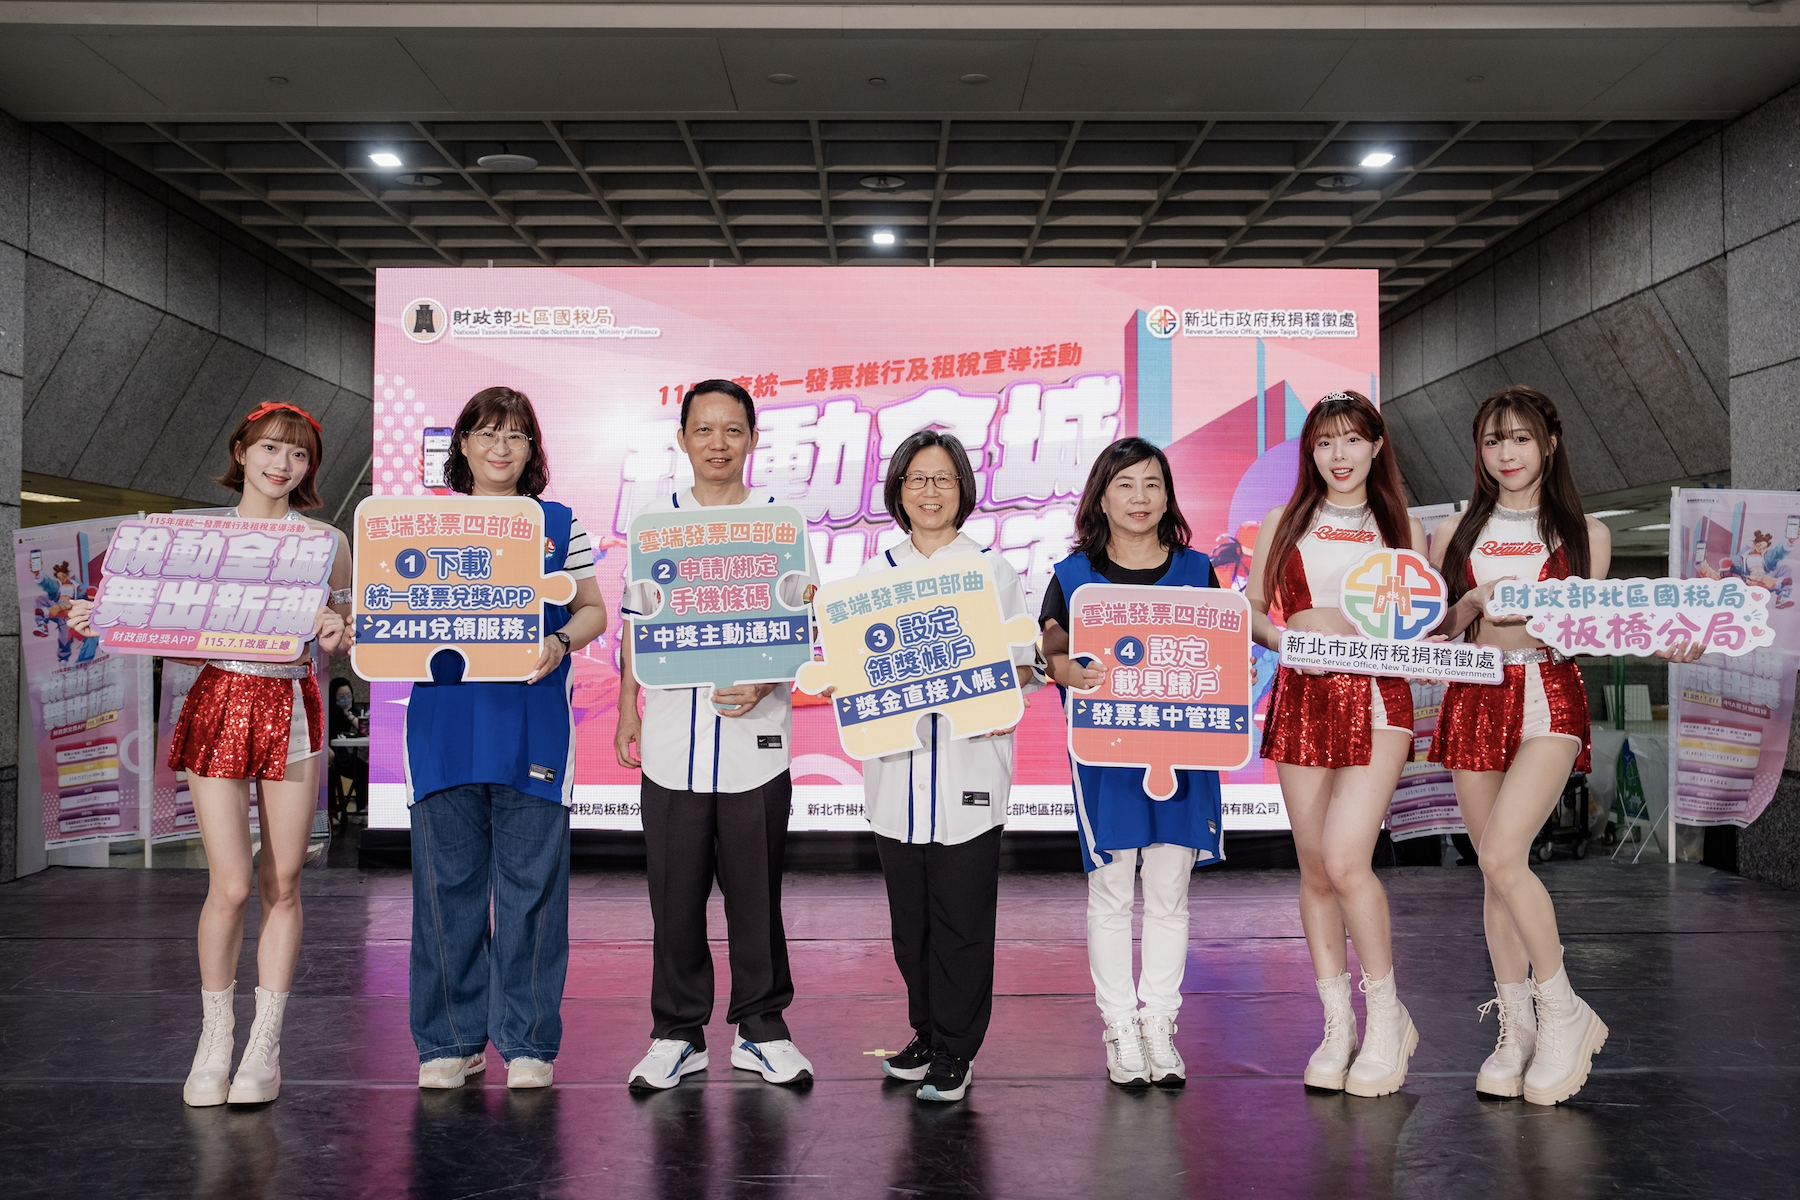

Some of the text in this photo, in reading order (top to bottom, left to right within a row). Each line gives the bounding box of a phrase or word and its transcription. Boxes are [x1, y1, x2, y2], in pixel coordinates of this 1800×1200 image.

[453, 309, 612, 326] 財政部北區國稅局
[1184, 311, 1355, 328] 新北市政府稅捐稽徵處
[599, 328, 625, 338] Ministry
[1280, 329, 1299, 337] Taipei
[1300, 329, 1313, 337] City
[149, 516, 306, 533] 115年度統一發票推行及租稅宣導活動
[366, 512, 533, 541] 雲端發票四部曲
[638, 521, 797, 554] 雲端發票四部曲
[428, 547, 491, 580] 下載
[678, 553, 779, 583] 申請/綁定
[92, 575, 325, 637] 舞出新潮
[365, 584, 535, 610] 統一發票兌獎APP
[669, 583, 773, 616] 手機條碼
[826, 570, 984, 625] 雲端發票四部曲
[374, 617, 525, 641] 24H兌領服務
[897, 606, 962, 646] 設定
[1081, 602, 1242, 632] 雲端發票四部曲
[1556, 612, 1747, 650] 板橋分局
[203, 637, 291, 651] 115.7.1改版上線
[653, 620, 791, 650] 中獎主動通知
[865, 636, 975, 687] 領獎帳戶
[1147, 635, 1209, 668] 設定
[1287, 636, 1495, 670] 新北市政府稅捐稽徵處
[1287, 655, 1496, 679] Revenue Service Office, New Taipei City Government
[856, 667, 997, 720] 獎金直接入帳
[1111, 666, 1220, 700] 載具歸戶
[1091, 702, 1231, 730] 發票集中管理
